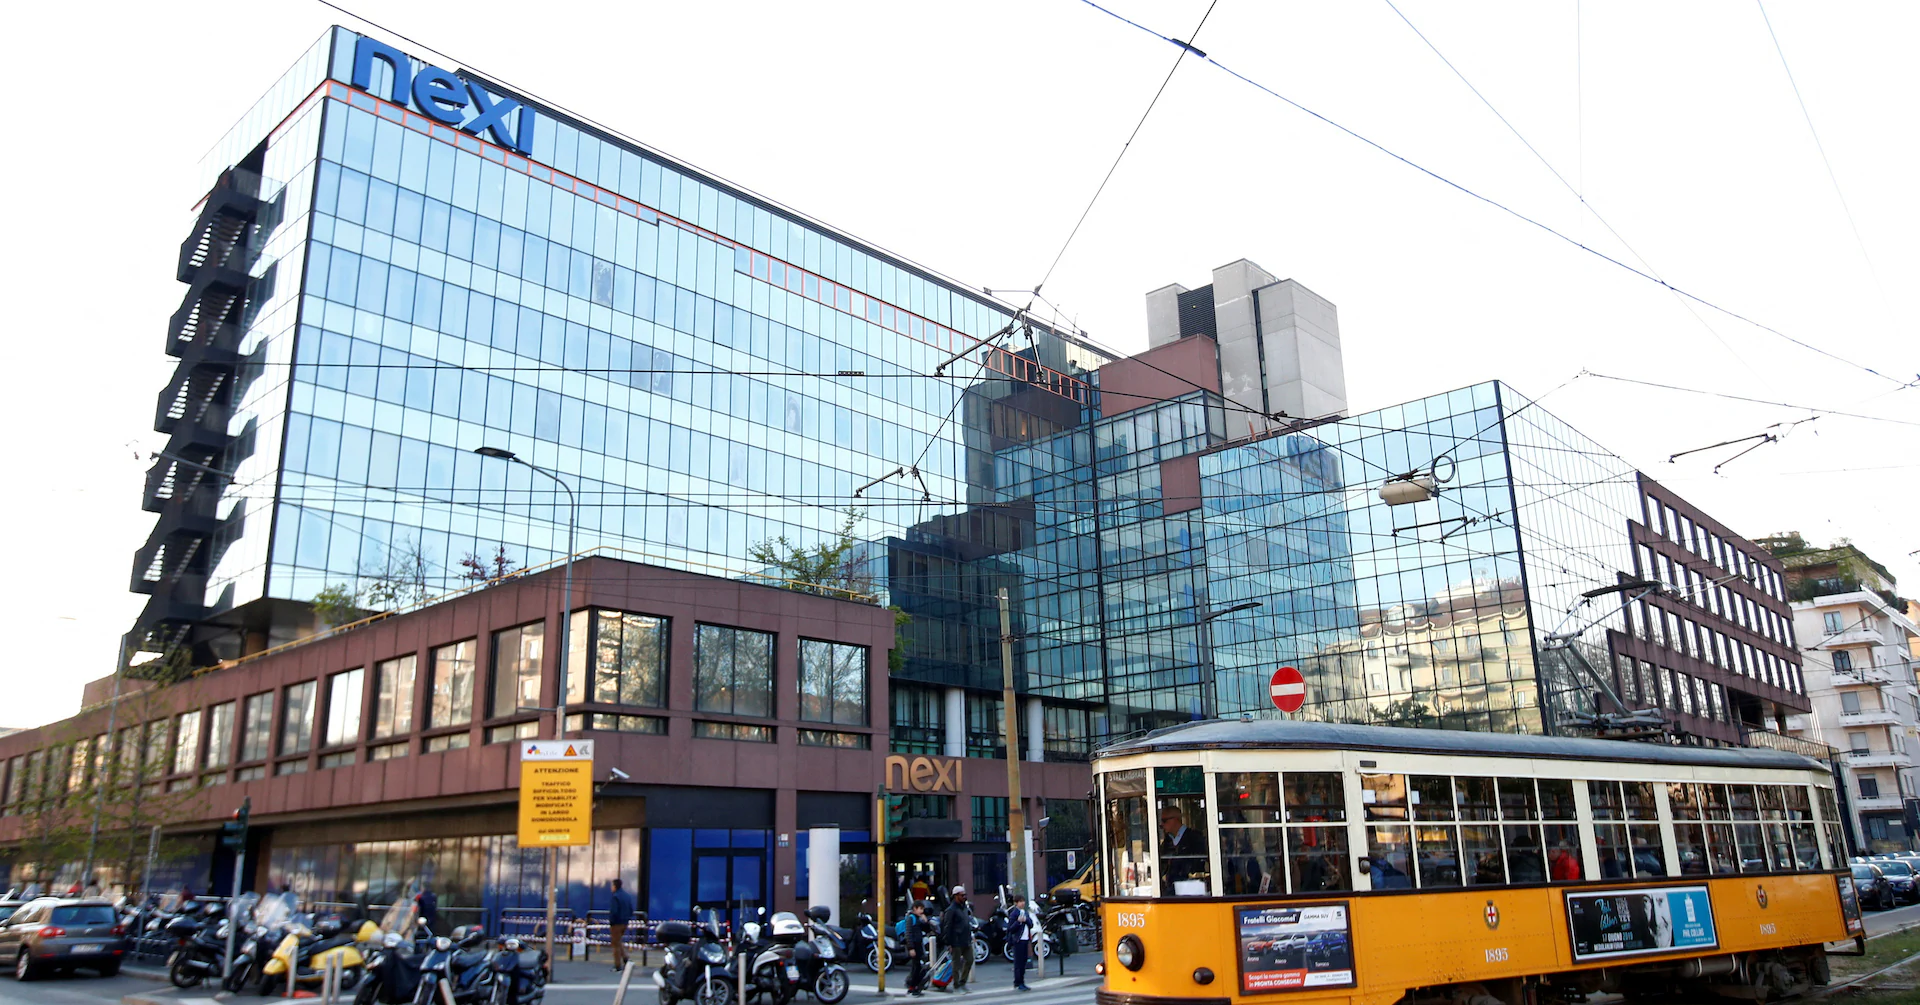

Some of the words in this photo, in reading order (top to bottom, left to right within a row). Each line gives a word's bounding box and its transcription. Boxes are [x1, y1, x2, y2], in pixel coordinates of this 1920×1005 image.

[352, 37, 536, 157] nexi
[885, 755, 963, 792] nexi
[1117, 912, 1145, 928] 1895
[1244, 916, 1265, 924] Fratelli
[1760, 922, 1776, 935] 1895
[1485, 948, 1508, 963] 1895
